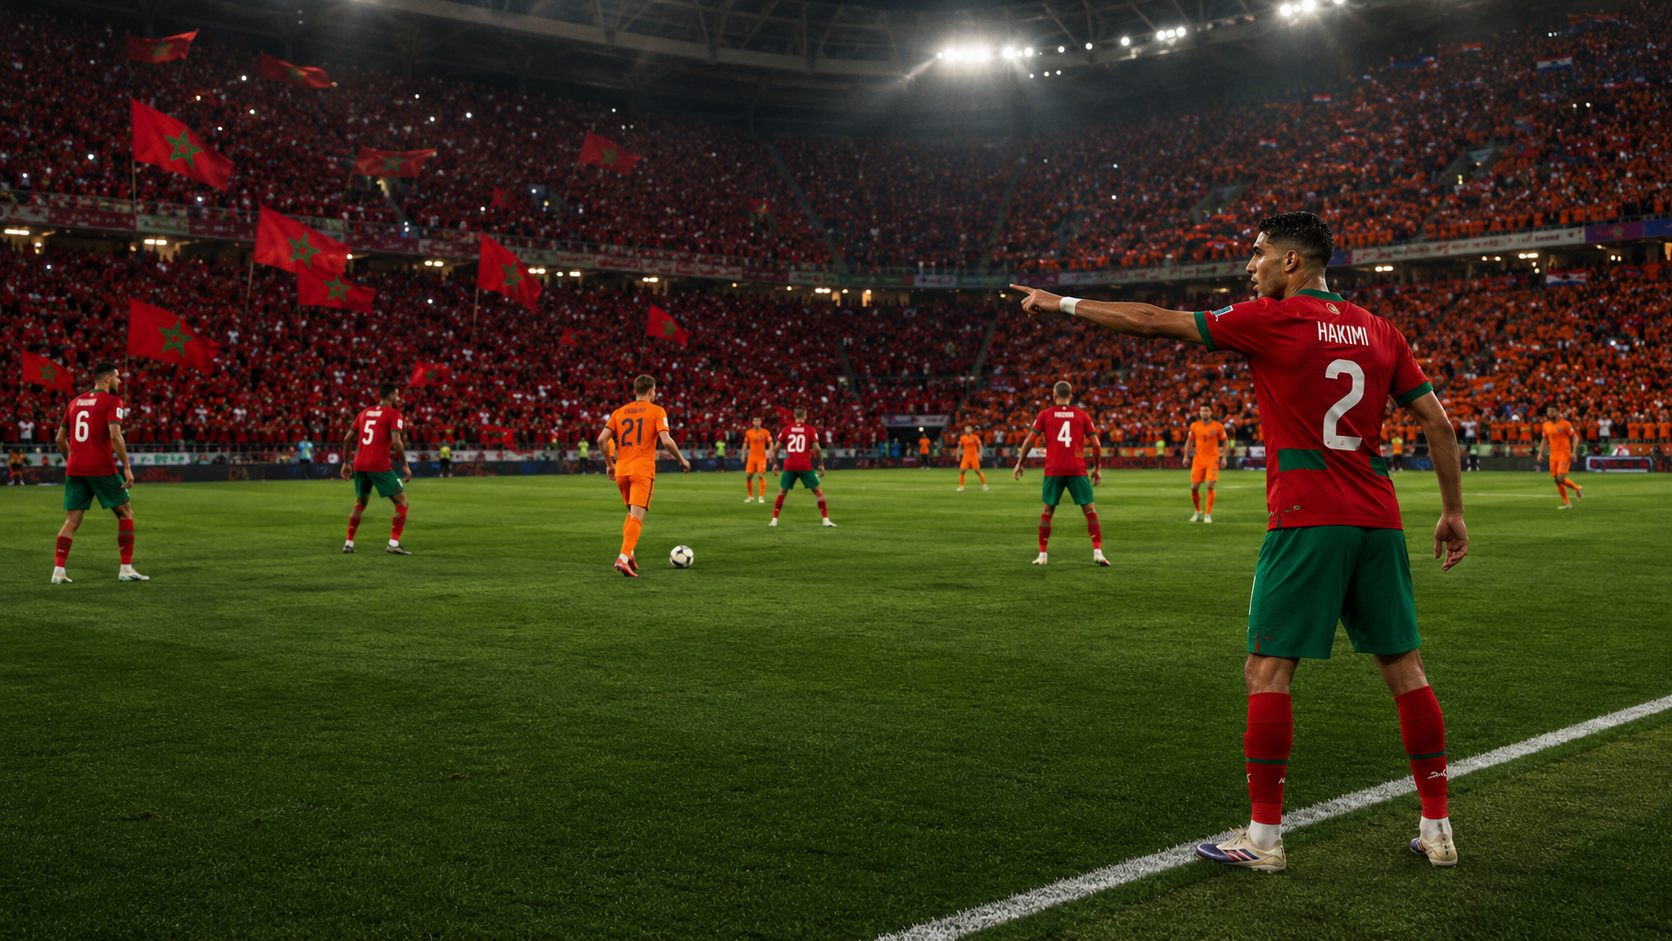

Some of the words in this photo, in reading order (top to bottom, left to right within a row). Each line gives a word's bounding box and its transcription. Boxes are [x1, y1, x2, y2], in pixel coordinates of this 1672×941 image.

[1317, 320, 1369, 346] HAKIMI
[1323, 358, 1365, 451] 2
[75, 410, 90, 442] 6
[362, 420, 377, 445] 5
[621, 417, 643, 447] 21
[1057, 421, 1072, 448] 4
[787, 434, 806, 453] 20
